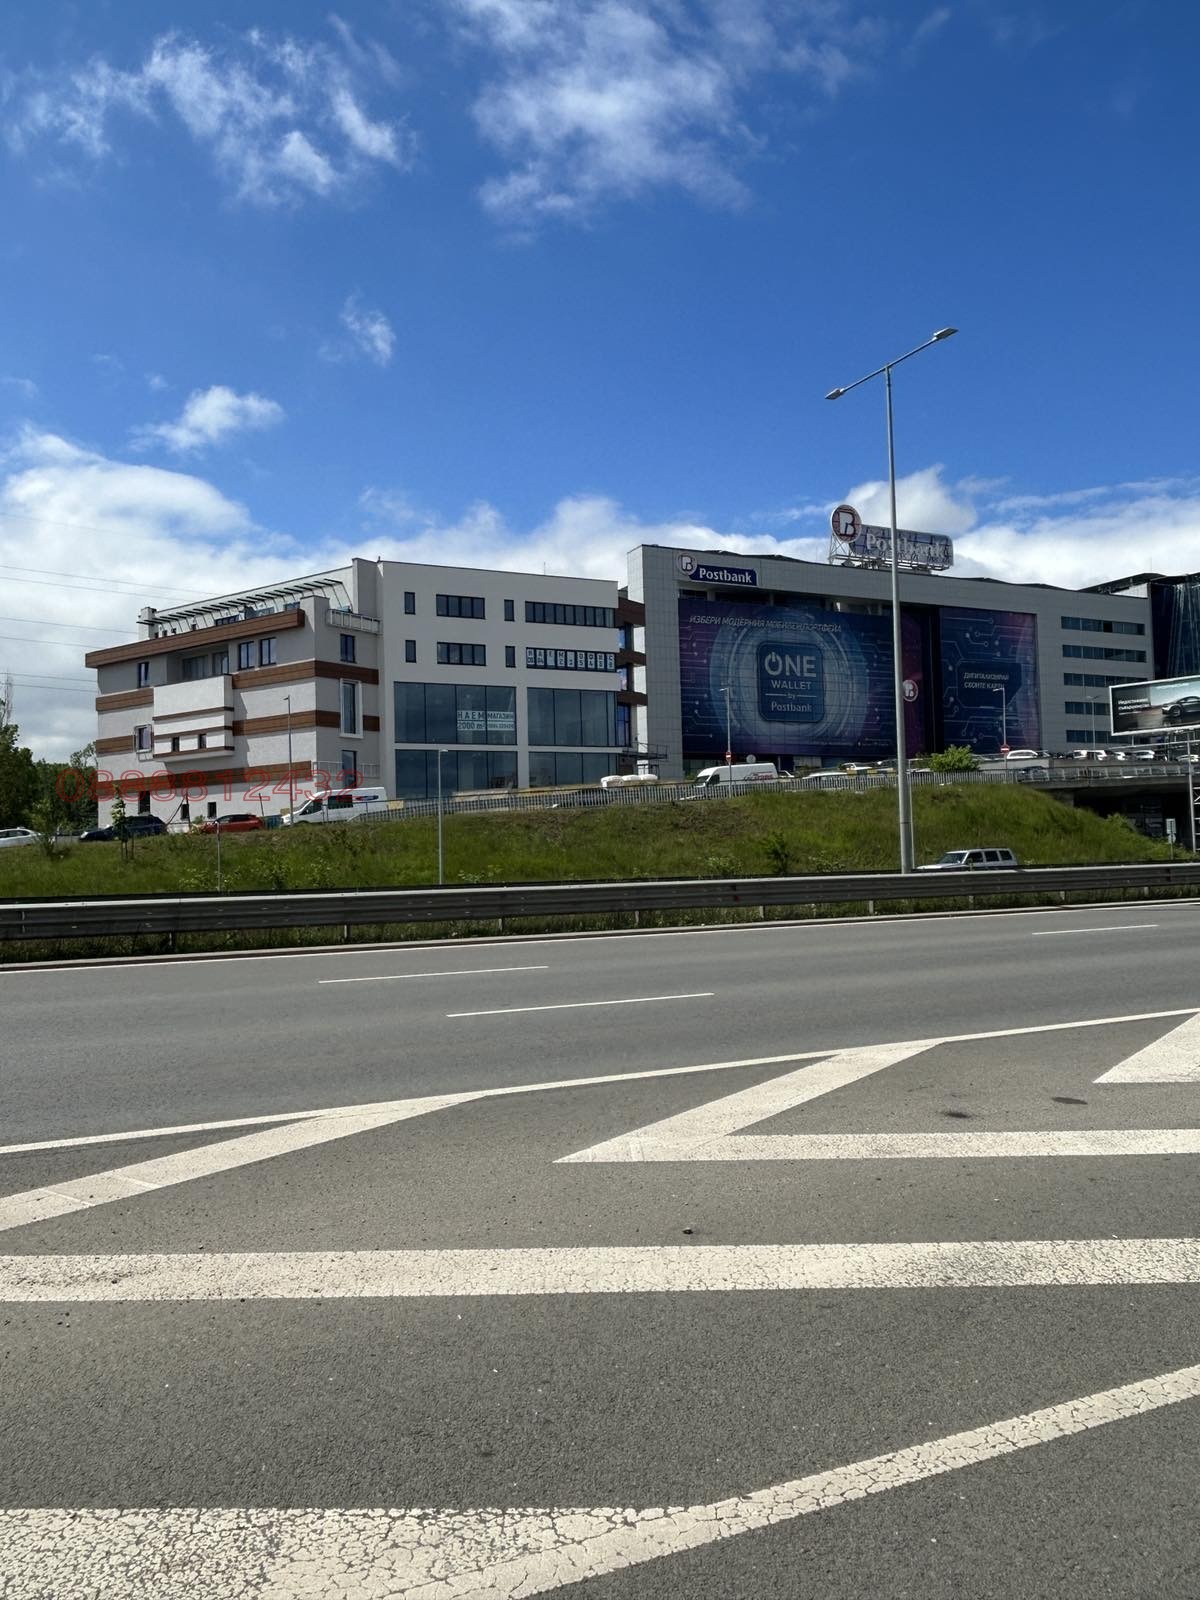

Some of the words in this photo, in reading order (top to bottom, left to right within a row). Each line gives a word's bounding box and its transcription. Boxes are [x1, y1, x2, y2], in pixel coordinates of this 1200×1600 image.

[699, 568, 752, 583] Postbank
[688, 615, 721, 625] ИЗБЕРИ
[764, 651, 817, 678] ONE
[771, 680, 812, 690] WALLET
[787, 692, 797, 700] by
[771, 701, 812, 713] Postbank
[457, 711, 485, 720] НАЕМ
[457, 722, 475, 730] 2000
